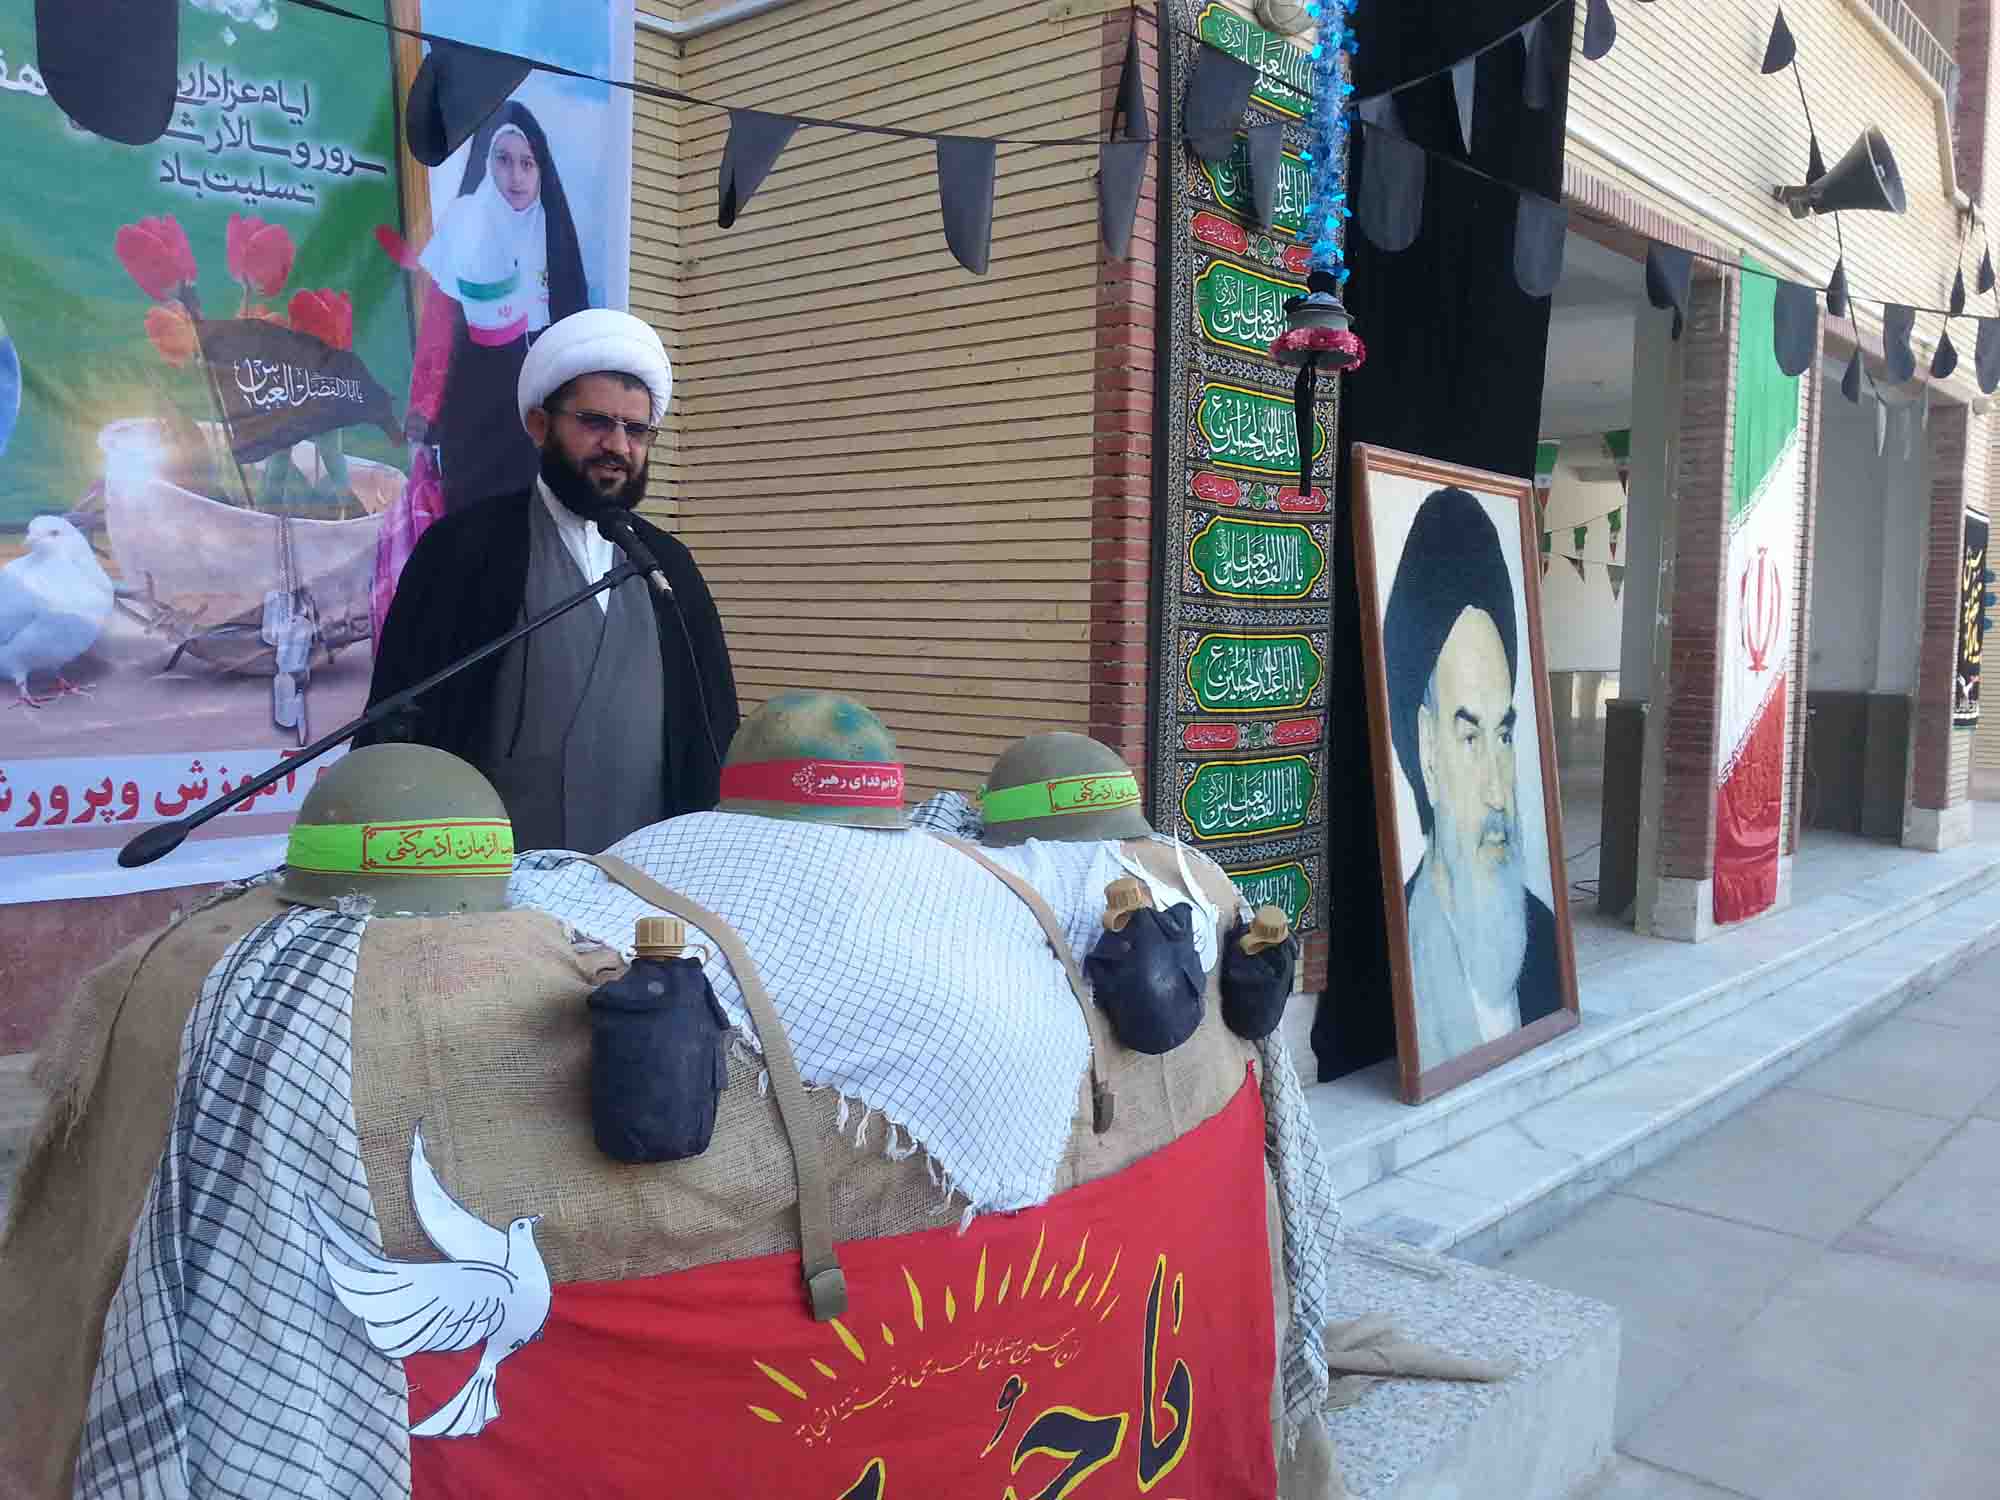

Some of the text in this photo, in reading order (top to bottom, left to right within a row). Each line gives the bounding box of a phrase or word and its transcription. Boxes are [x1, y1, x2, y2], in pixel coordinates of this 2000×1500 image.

[262, 78, 310, 125] ایام
[160, 152, 316, 206] تسلیت باد
